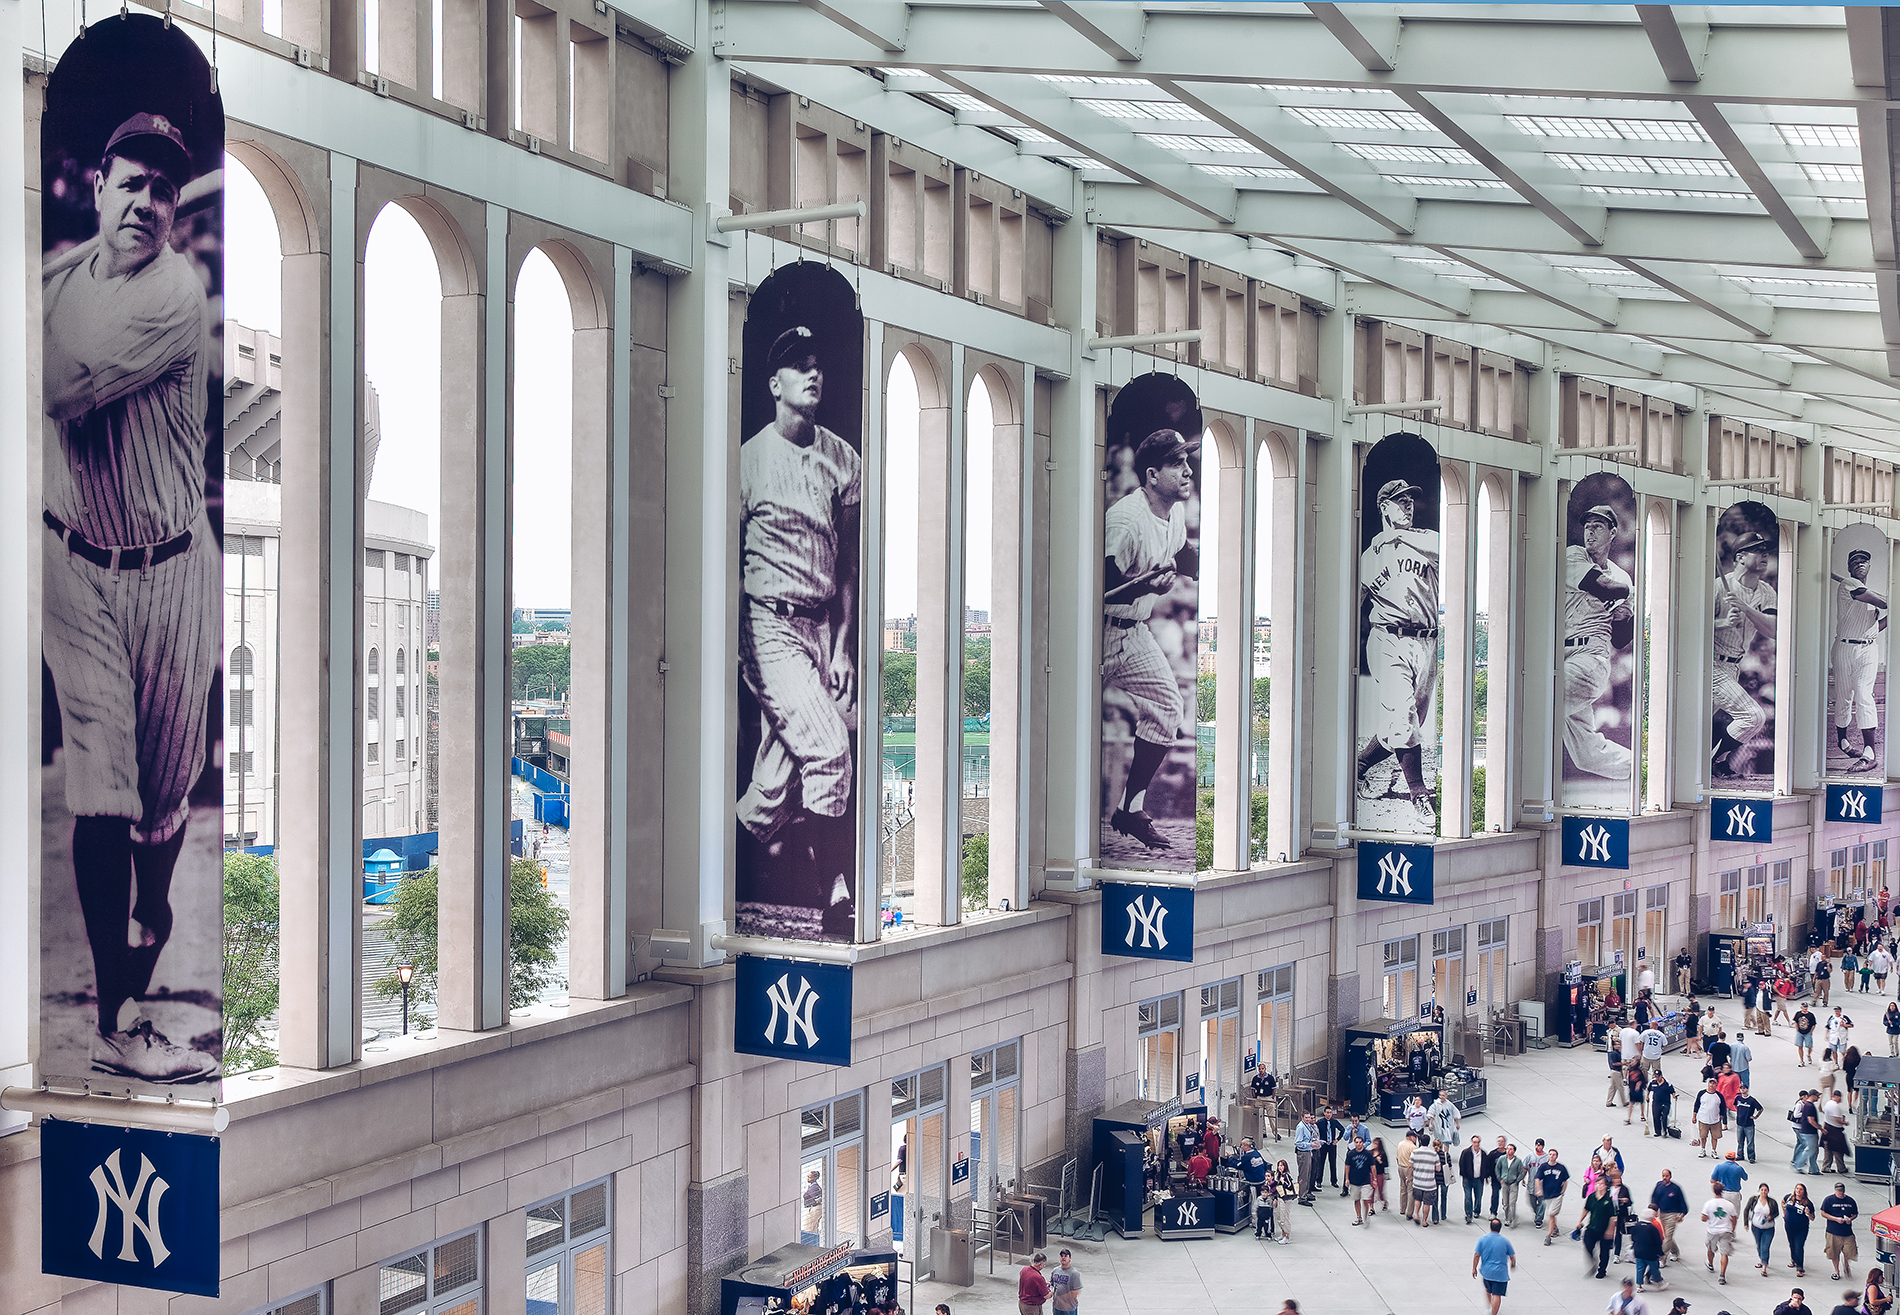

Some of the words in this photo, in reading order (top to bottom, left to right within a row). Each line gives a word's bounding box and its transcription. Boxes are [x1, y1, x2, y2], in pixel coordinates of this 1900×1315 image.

[1369, 566, 1392, 594] NEW
[1397, 558, 1430, 579] YORK
[1726, 803, 1756, 837] NY
[1840, 789, 1868, 819] NY
[1579, 823, 1612, 862] NY
[1377, 851, 1413, 896] NY
[1124, 894, 1169, 951] NY
[763, 972, 821, 1049] NY
[1648, 1037, 1659, 1047] 15
[87, 1147, 171, 1269] NY
[1177, 1201, 1199, 1226] NY
[793, 1264, 811, 1283] NIKE
